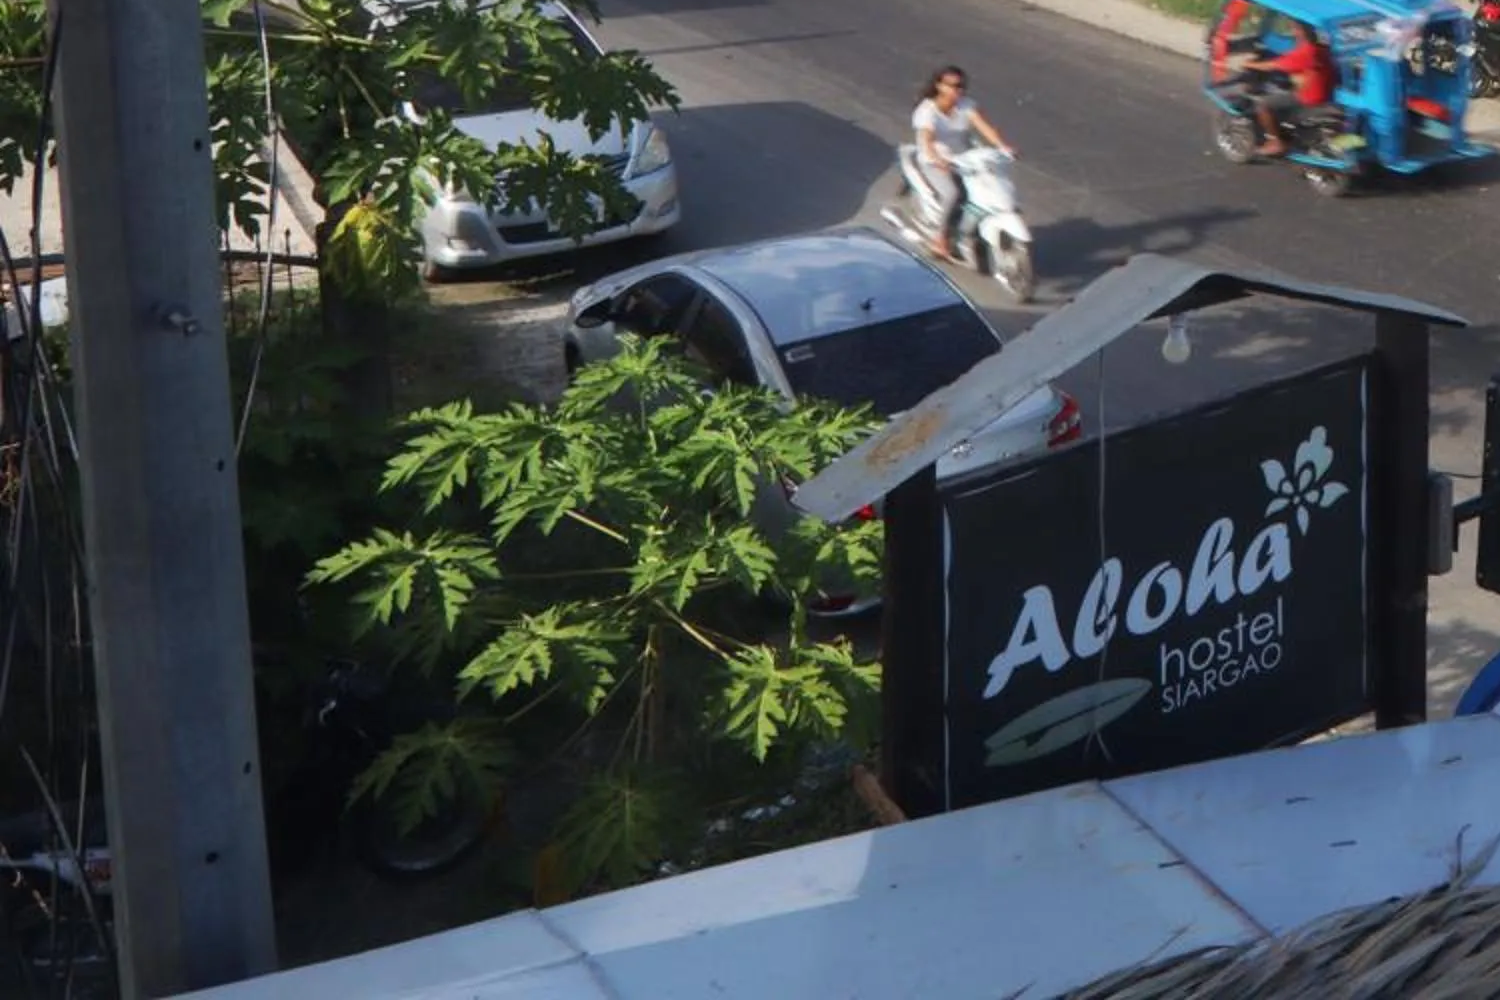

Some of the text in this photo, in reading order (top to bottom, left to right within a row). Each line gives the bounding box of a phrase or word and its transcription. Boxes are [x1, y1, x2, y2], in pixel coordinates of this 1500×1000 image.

[982, 516, 1293, 699] Aloha
[1160, 595, 1284, 686] hostel
[1161, 642, 1282, 714] SIARGAO
